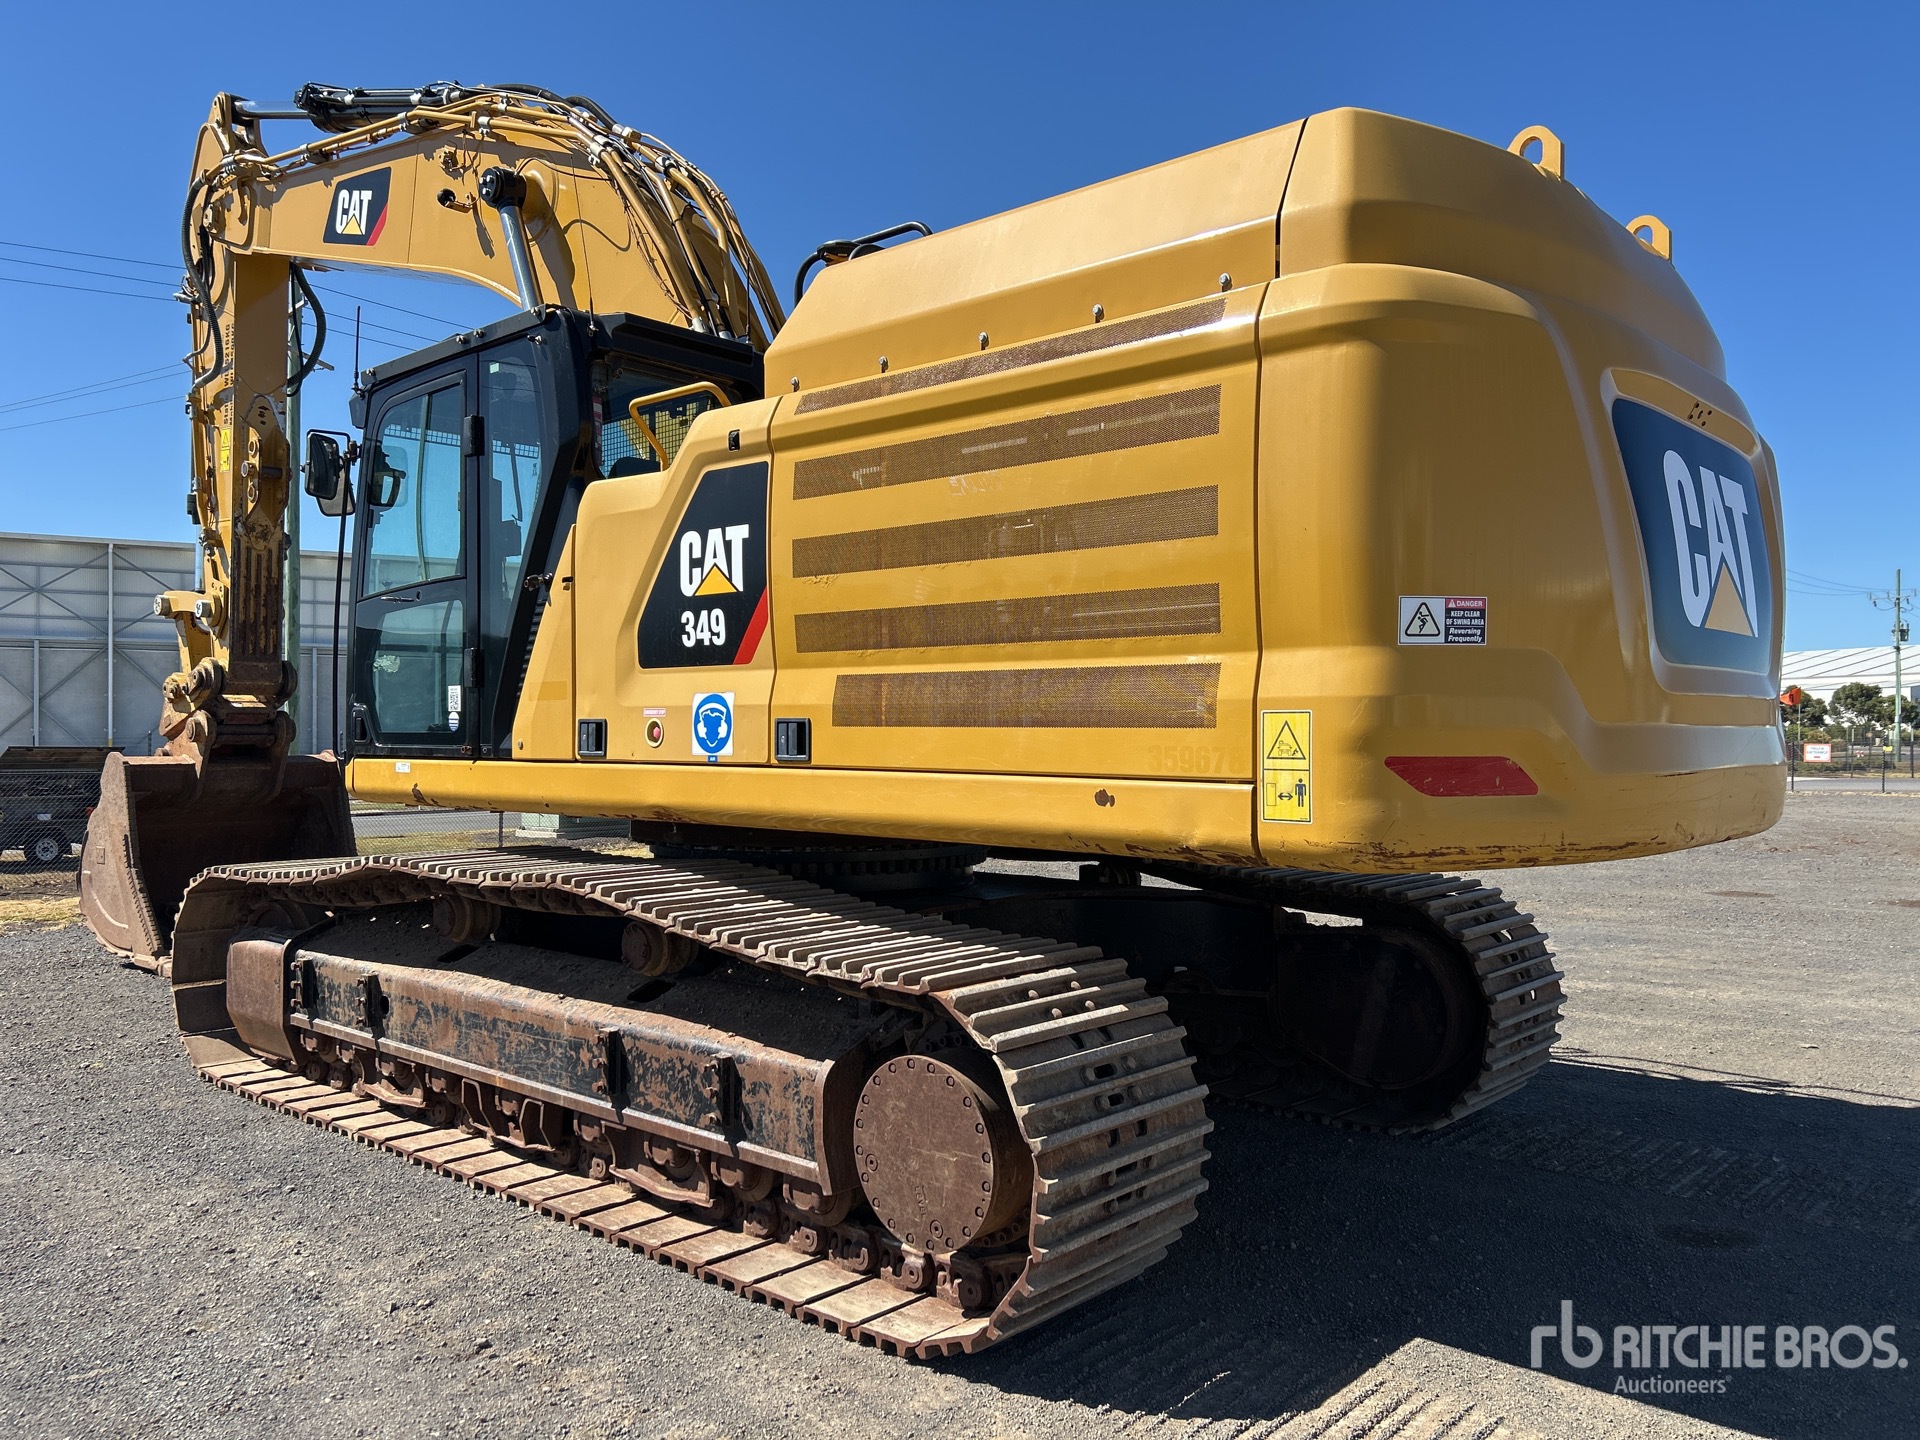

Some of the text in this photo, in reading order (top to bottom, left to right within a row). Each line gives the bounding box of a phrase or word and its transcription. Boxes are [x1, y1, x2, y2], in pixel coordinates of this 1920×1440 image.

[335, 189, 373, 235] CAT
[680, 523, 749, 597] CAT
[1663, 450, 1758, 638] CAT
[681, 608, 726, 648] 349
[1449, 627, 1481, 636] Reversing
